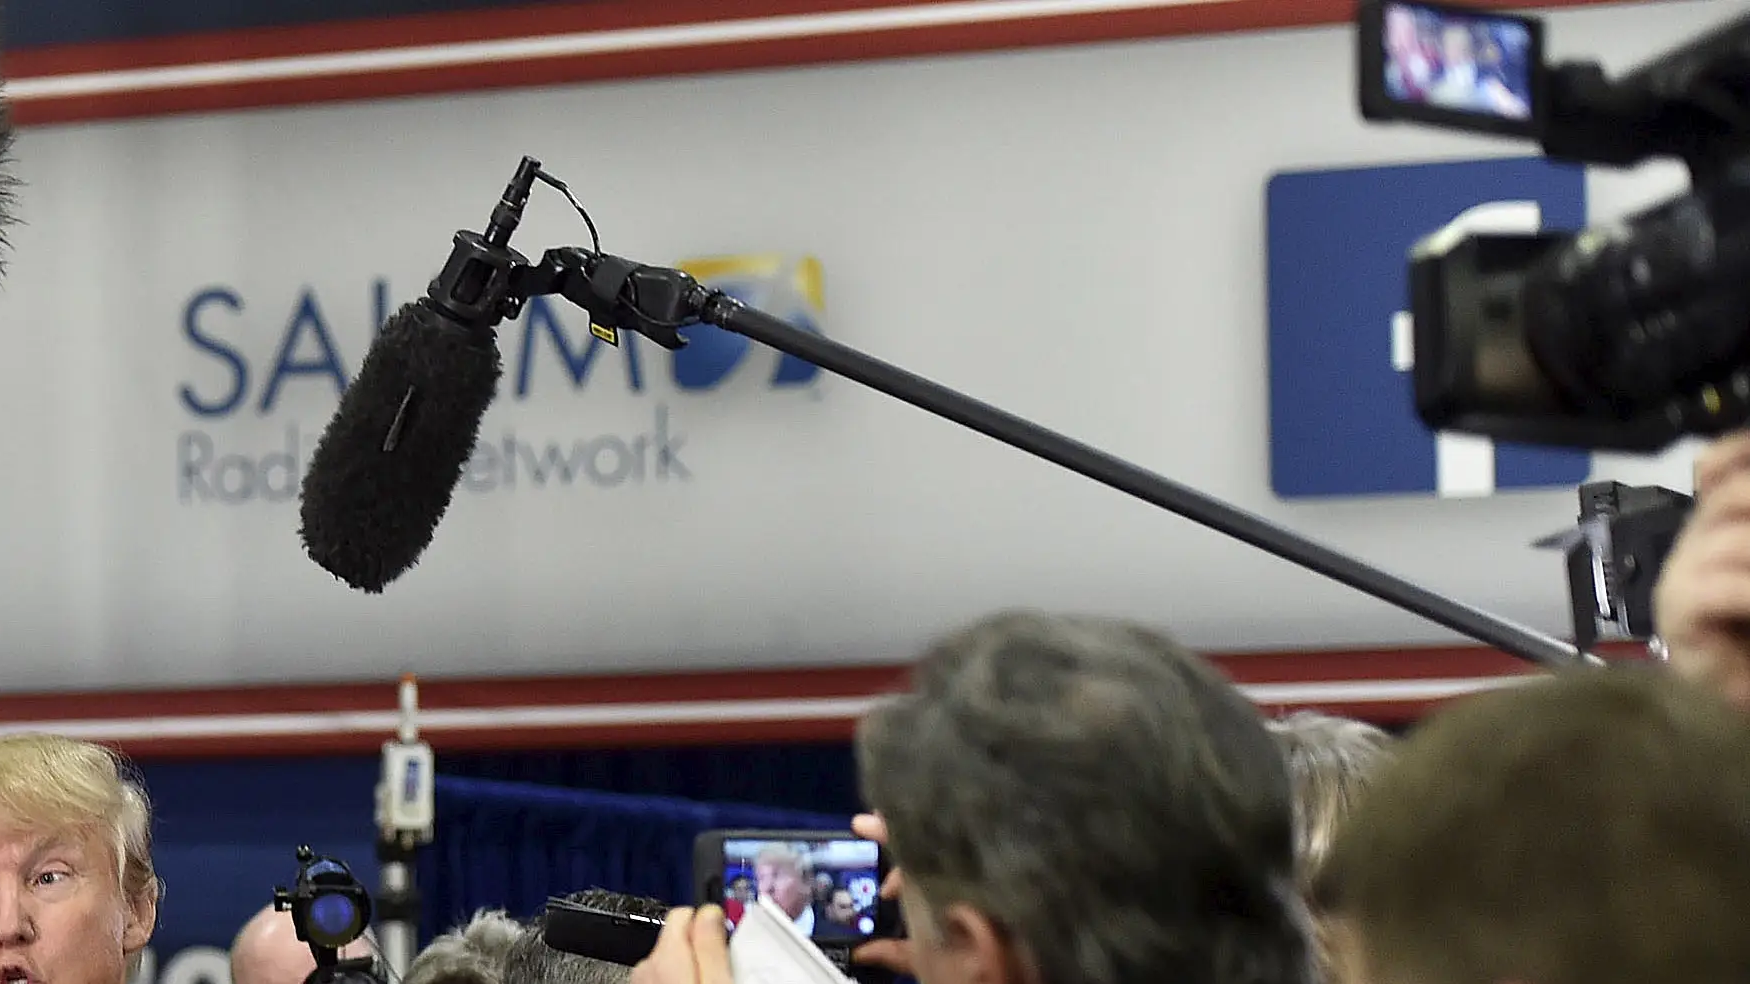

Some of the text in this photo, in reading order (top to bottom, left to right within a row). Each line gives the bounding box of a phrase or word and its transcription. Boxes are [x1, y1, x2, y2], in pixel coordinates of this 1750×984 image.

[178, 277, 644, 416] SAM
[176, 402, 693, 504] Rad etwork
